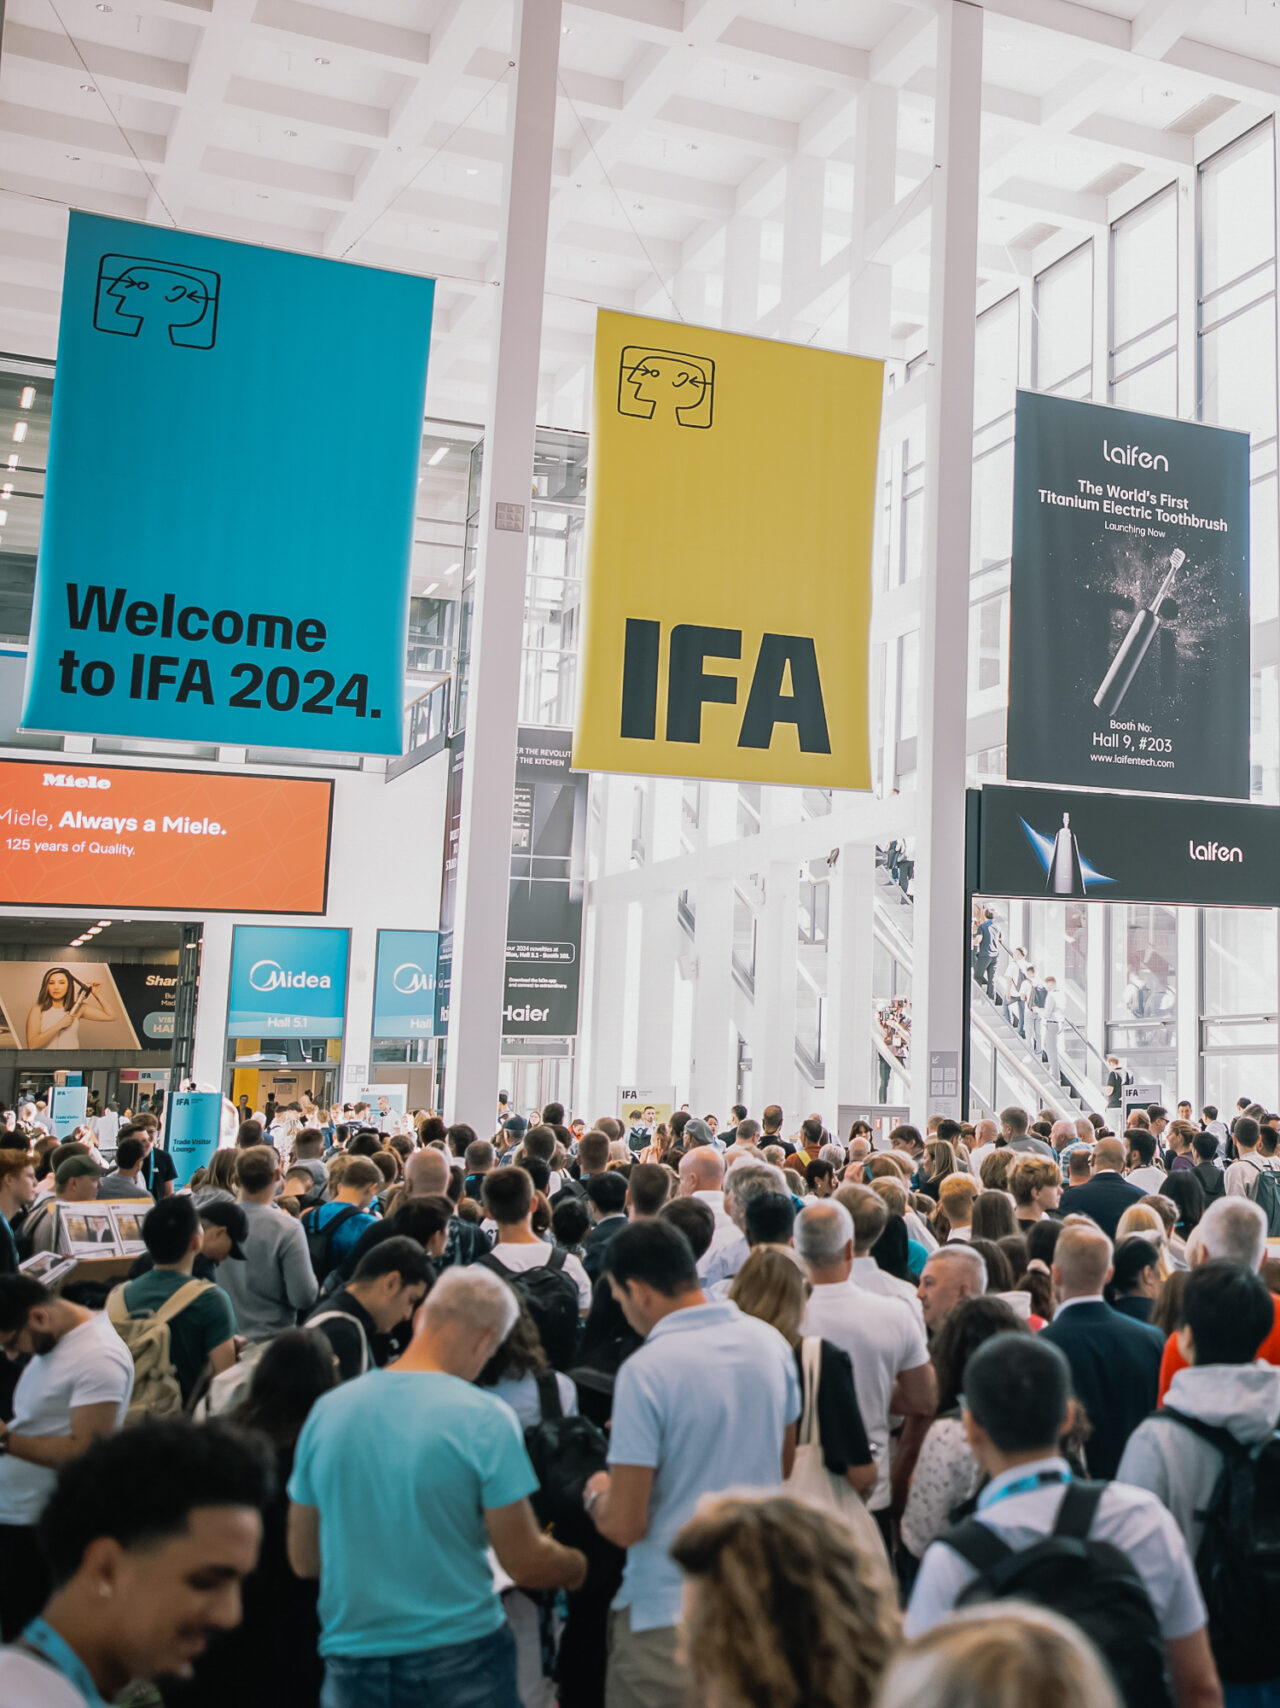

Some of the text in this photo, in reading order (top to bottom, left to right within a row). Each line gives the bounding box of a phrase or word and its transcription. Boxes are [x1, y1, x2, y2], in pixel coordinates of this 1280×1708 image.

[1078, 479, 1189, 510] The World's First
[1038, 489, 1228, 532] Titanium Electric Toothbrush
[1105, 520, 1166, 538] Launching Now
[66, 582, 327, 652] Welcome
[59, 650, 382, 719] to IFA 2024.
[621, 617, 832, 755] IFA
[1110, 719, 1152, 732] Booth No:
[1092, 732, 1173, 752] Hall 9, #203
[1090, 753, 1175, 768] www.laifentech.com
[42, 773, 111, 790] Miele
[58, 811, 138, 834] Always
[143, 819, 156, 832] a
[162, 816, 227, 836] Miele.
[6, 838, 135, 857] 125 years of Quality.
[257, 966, 331, 990] Midea
[267, 1016, 291, 1028] Hall
[176, 1098, 190, 1106] IFA
[622, 1090, 637, 1099] IFA
[1125, 1089, 1138, 1097] IFA
[172, 1146, 196, 1154] Lounge
[174, 1138, 211, 1146] Trade Visitor
